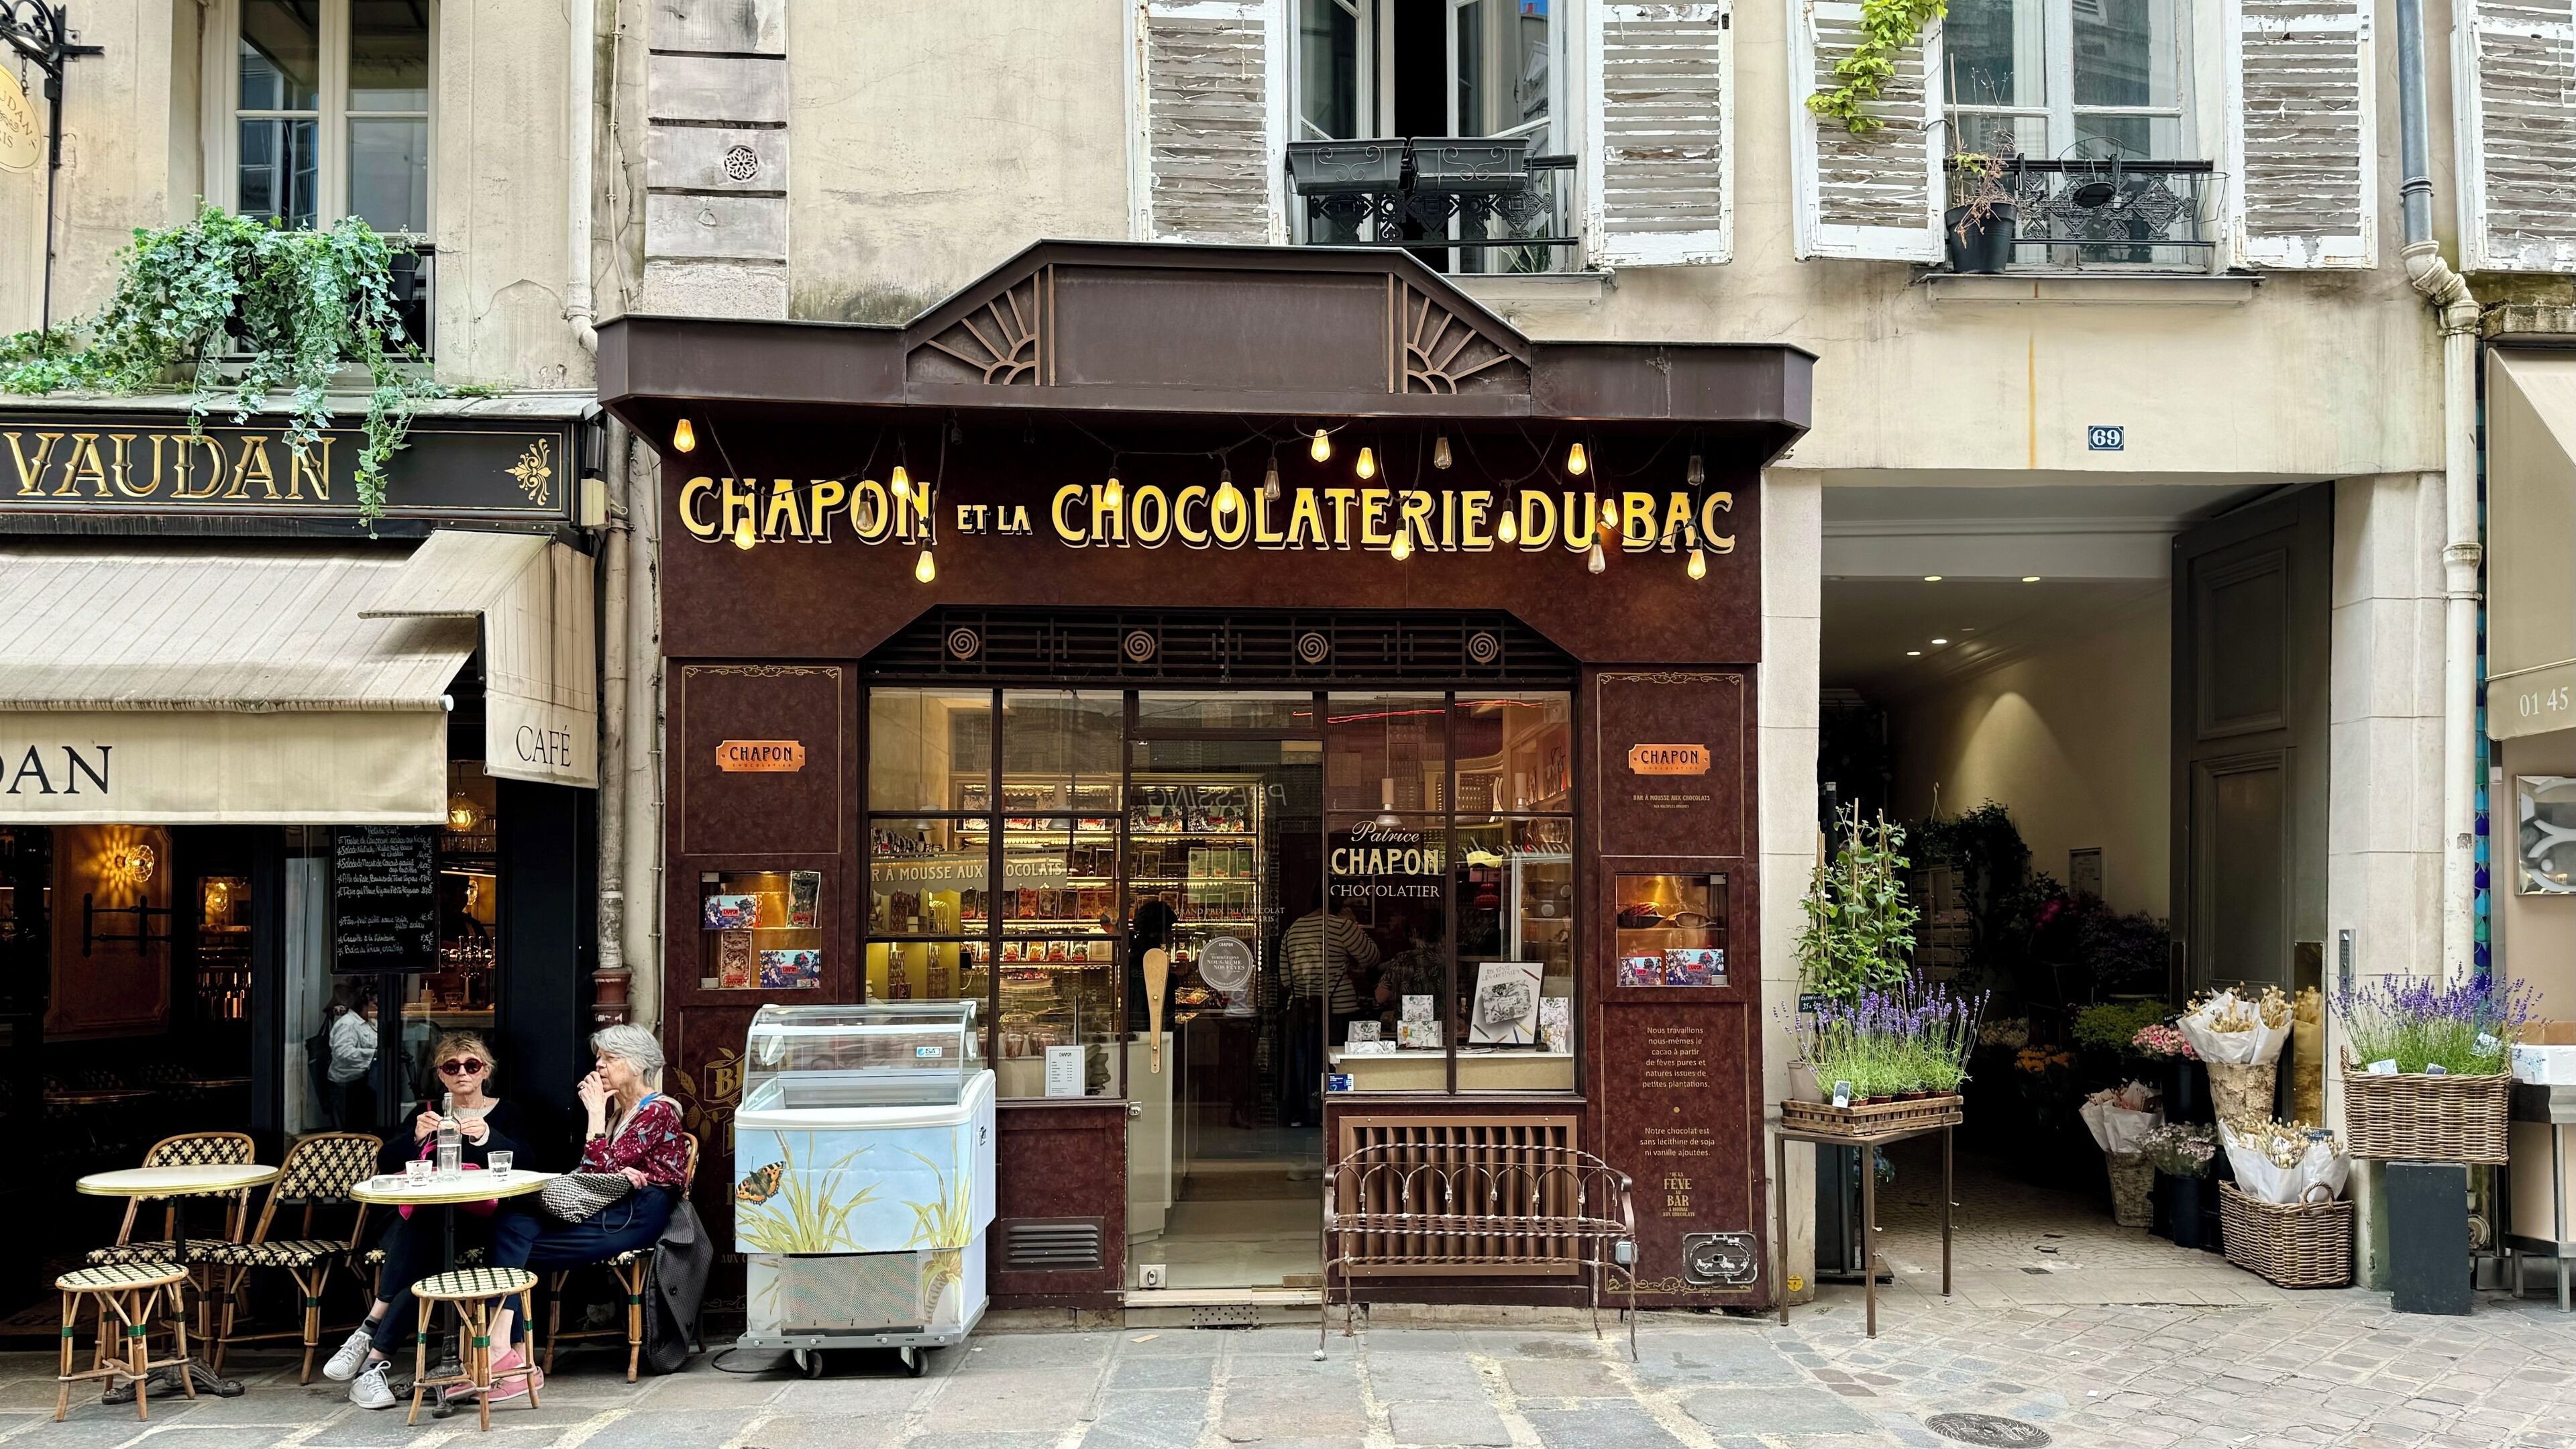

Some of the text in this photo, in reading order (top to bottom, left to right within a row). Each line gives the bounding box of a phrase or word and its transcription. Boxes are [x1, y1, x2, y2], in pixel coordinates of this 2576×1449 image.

[0, 90, 32, 136] UDAN
[0, 132, 13, 148] IS
[2092, 429, 2121, 446] 69
[3, 431, 337, 500] VAUDAN
[679, 476, 1736, 555] CHAPON ET LA CHOCOLATERIE DU BAC
[2519, 686, 2569, 717] 01 45
[515, 724, 572, 767] CAFÉ
[729, 746, 793, 762] CHAPON
[1641, 750, 1699, 765] CHAPON
[0, 745, 113, 794] AN
[1350, 820, 1420, 843] Patrice
[1331, 847, 1440, 875] CHAPON
[885, 865, 895, 881] À
[900, 865, 952, 881] MOUSSE
[957, 865, 984, 879] AUX
[1004, 863, 1063, 877] OCOLATS
[1330, 884, 1440, 898] CHOCOLATIER
[1674, 1048, 1678, 1056] à
[1680, 1048, 1700, 1057] partir
[1646, 1059, 1655, 1067] de
[1656, 1058, 1676, 1067] fèves
[1677, 1060, 1697, 1068] pures
[1674, 1069, 1696, 1077] issues
[1697, 1069, 1707, 1077] de
[1642, 1080, 1711, 1089] petites plantations.
[1645, 1127, 1666, 1135] Notre
[1667, 1127, 1697, 1135] chocolat
[1657, 1138, 1688, 1146] lécithine
[1690, 1138, 1699, 1146] de
[1701, 1138, 1715, 1146] soja
[1645, 1148, 1711, 1157] ni vanille ajoutées.
[1664, 1177, 1693, 1190] FÈVE
[1667, 1195, 1689, 1207] BAR
